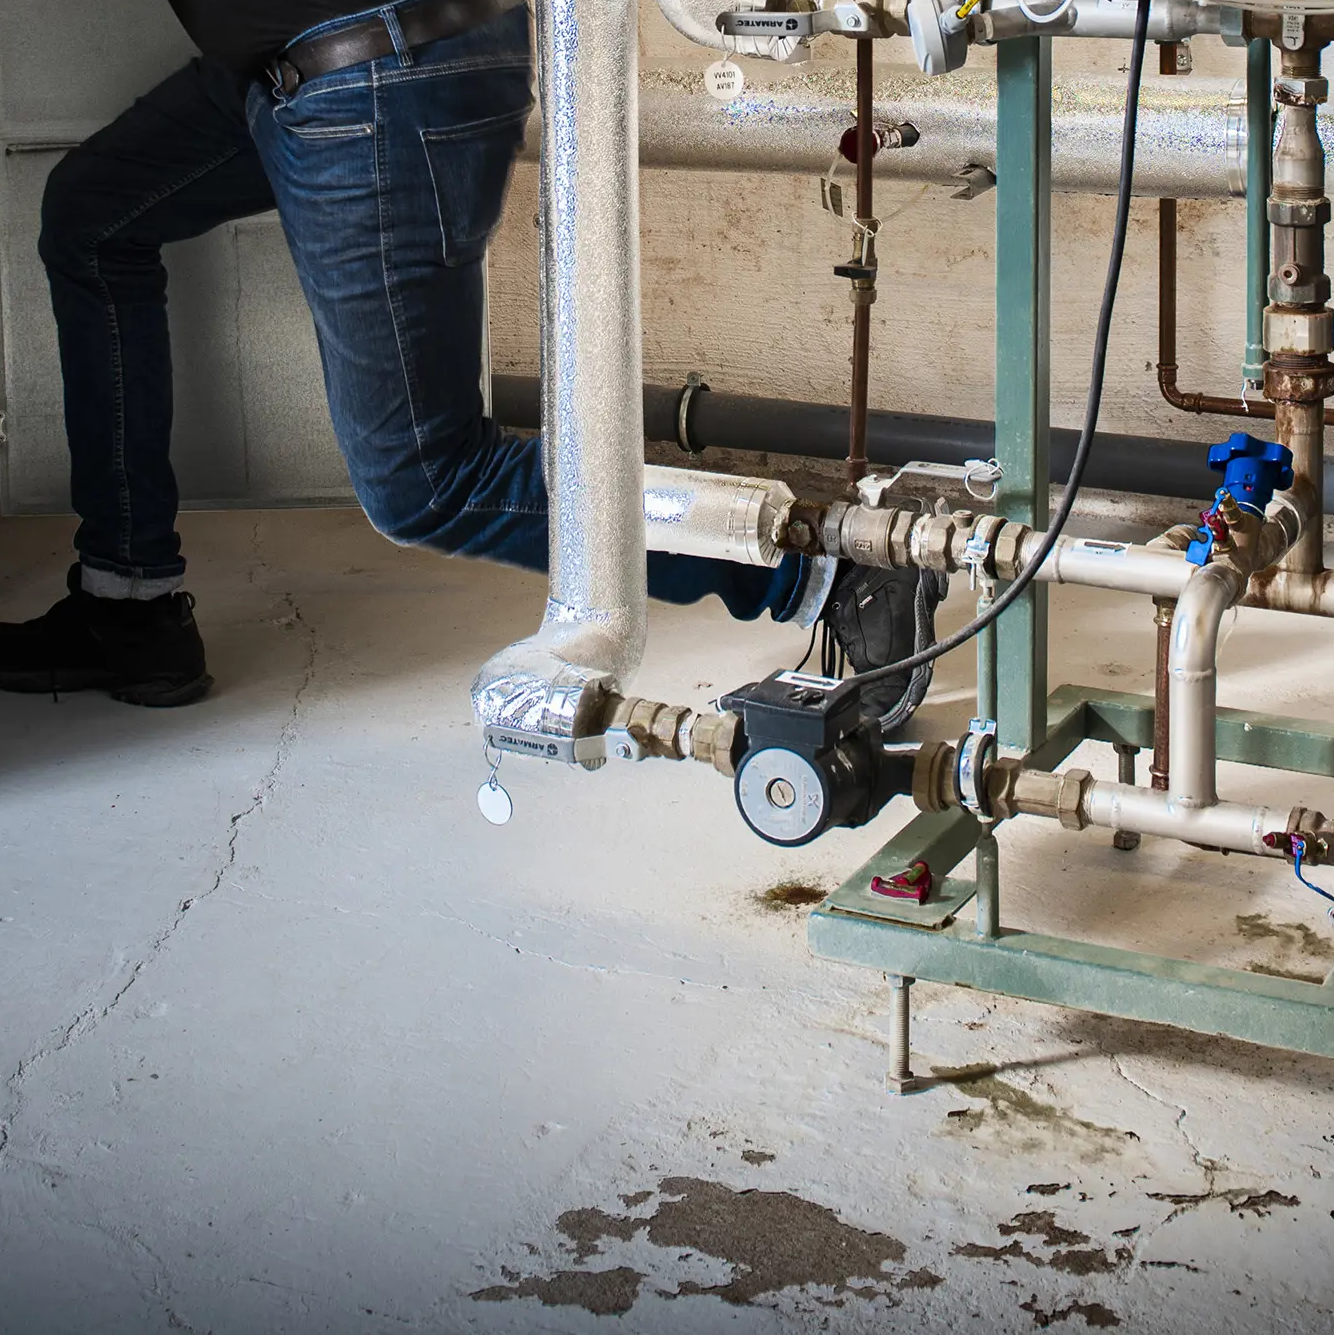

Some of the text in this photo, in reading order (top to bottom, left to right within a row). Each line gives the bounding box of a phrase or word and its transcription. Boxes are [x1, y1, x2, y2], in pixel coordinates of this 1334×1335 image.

[735, 20, 784, 28] ARMATEC
[713, 71, 736, 80] VV4101
[498, 735, 545, 750] ARMATEC
